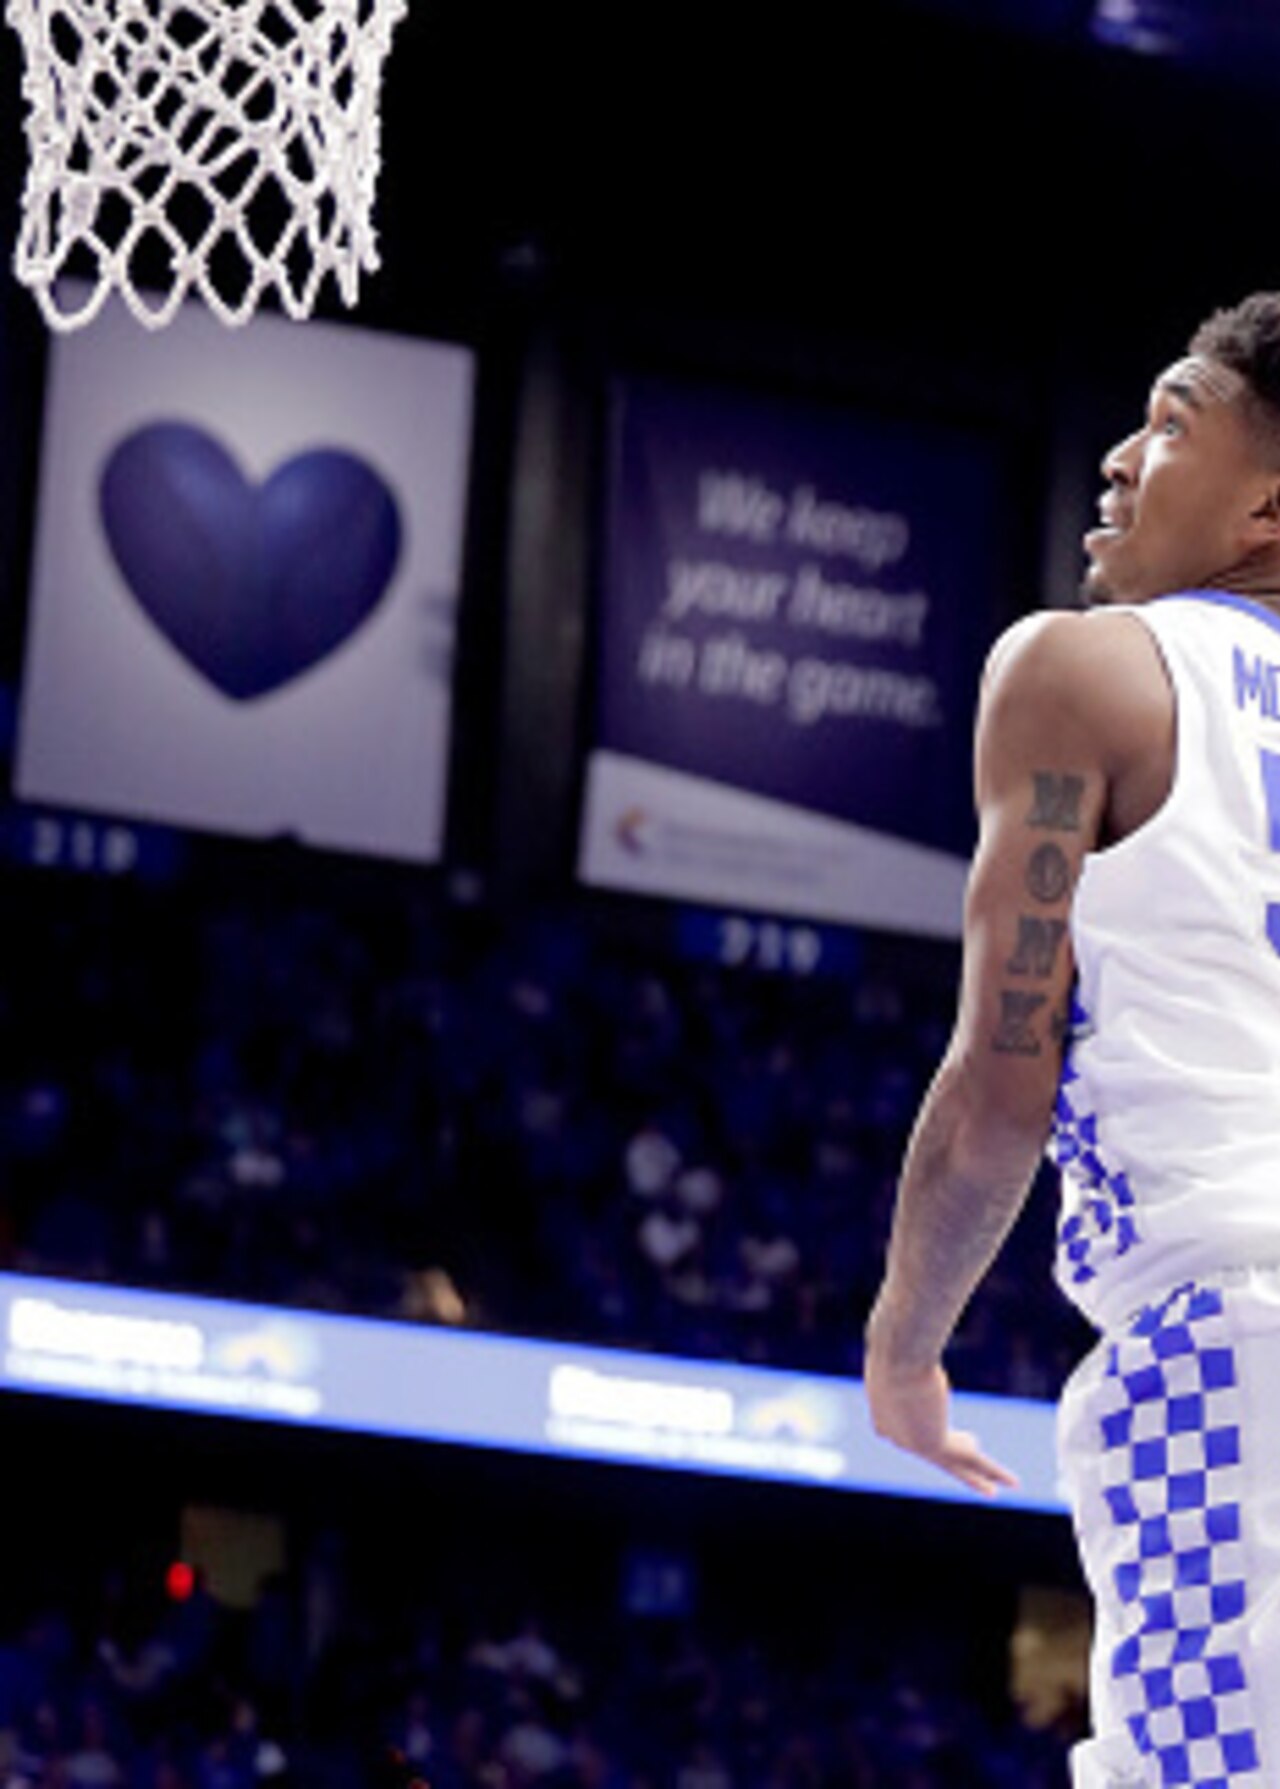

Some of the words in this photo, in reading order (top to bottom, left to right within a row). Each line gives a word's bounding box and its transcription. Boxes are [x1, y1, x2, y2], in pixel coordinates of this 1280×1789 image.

[700, 469, 783, 543] We
[787, 485, 908, 569] keep
[663, 558, 787, 621] your
[789, 563, 928, 646] heart
[637, 622, 695, 690] in
[700, 630, 787, 704] the
